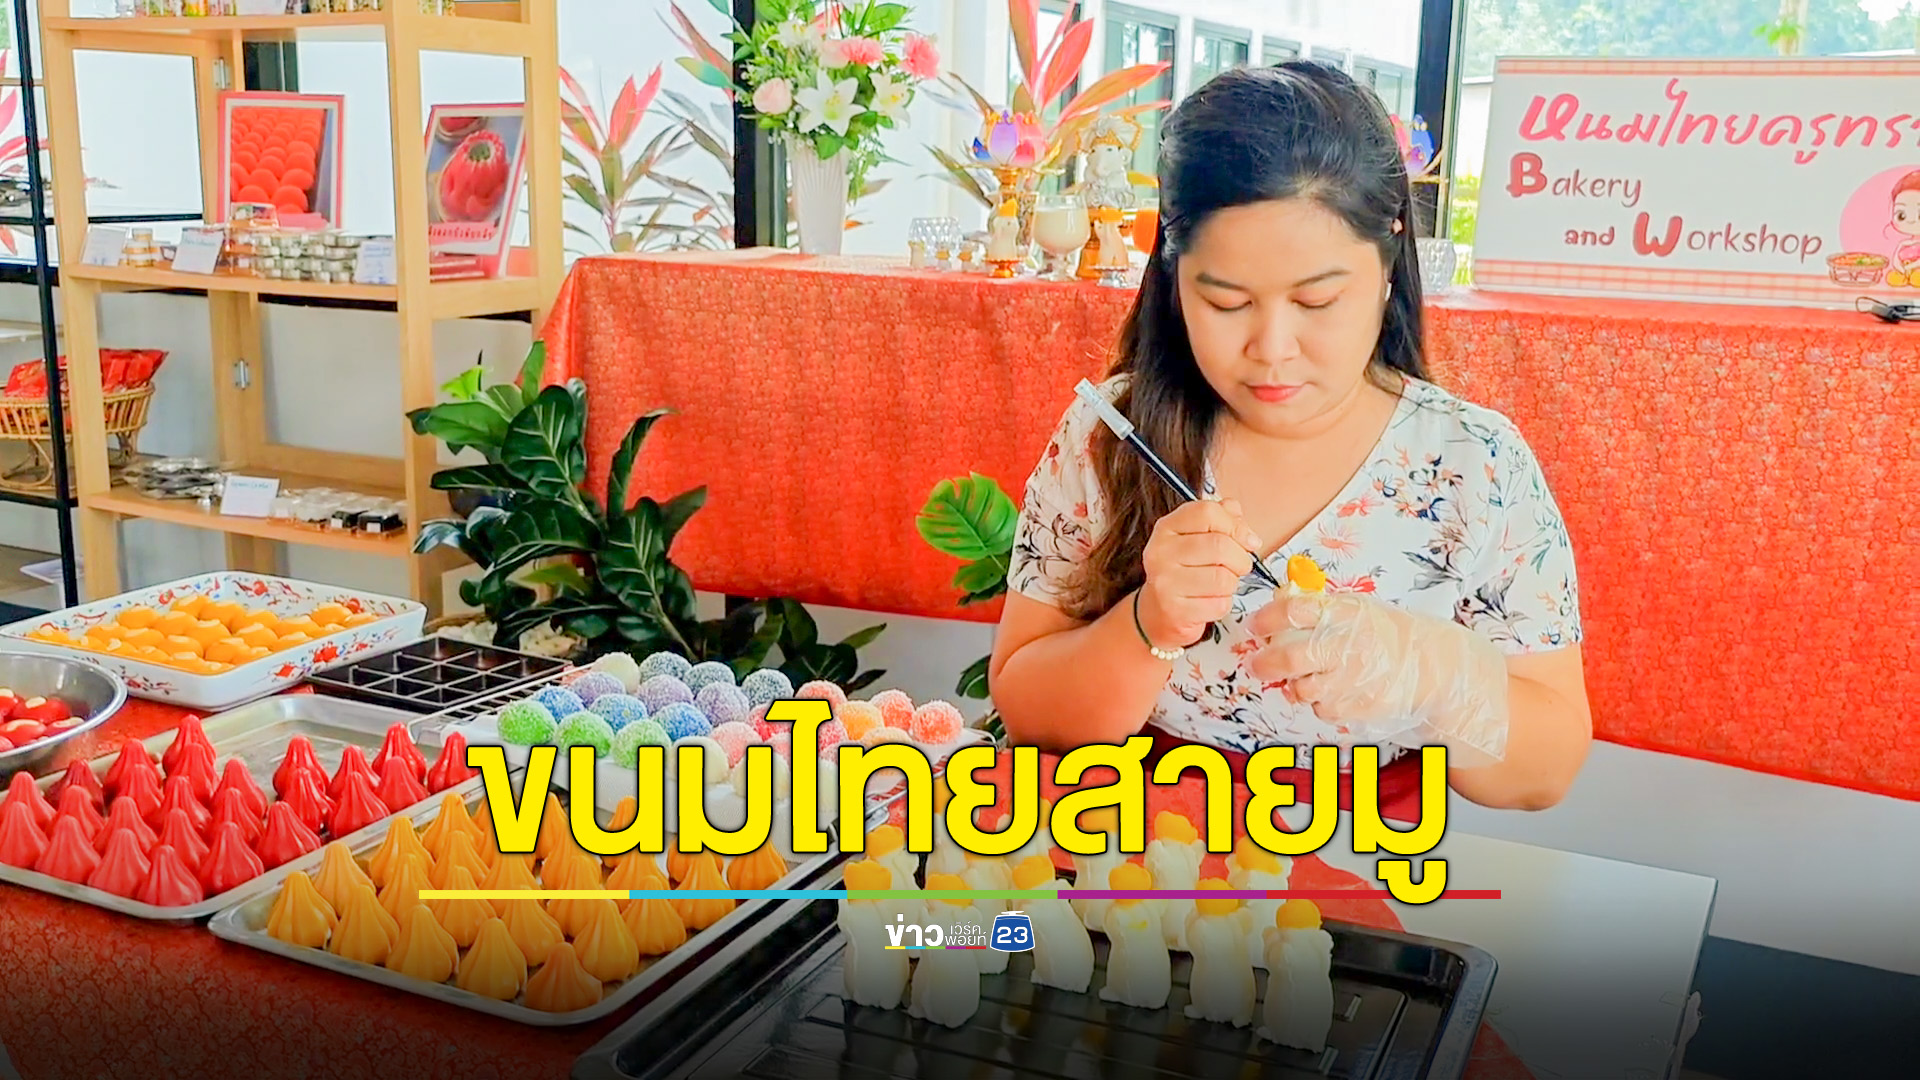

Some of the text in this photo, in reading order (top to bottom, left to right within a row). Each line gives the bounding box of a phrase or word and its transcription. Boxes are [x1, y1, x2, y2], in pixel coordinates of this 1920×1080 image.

[1506, 152, 1642, 208] Bakery
[1564, 211, 1823, 263] and Workshop
